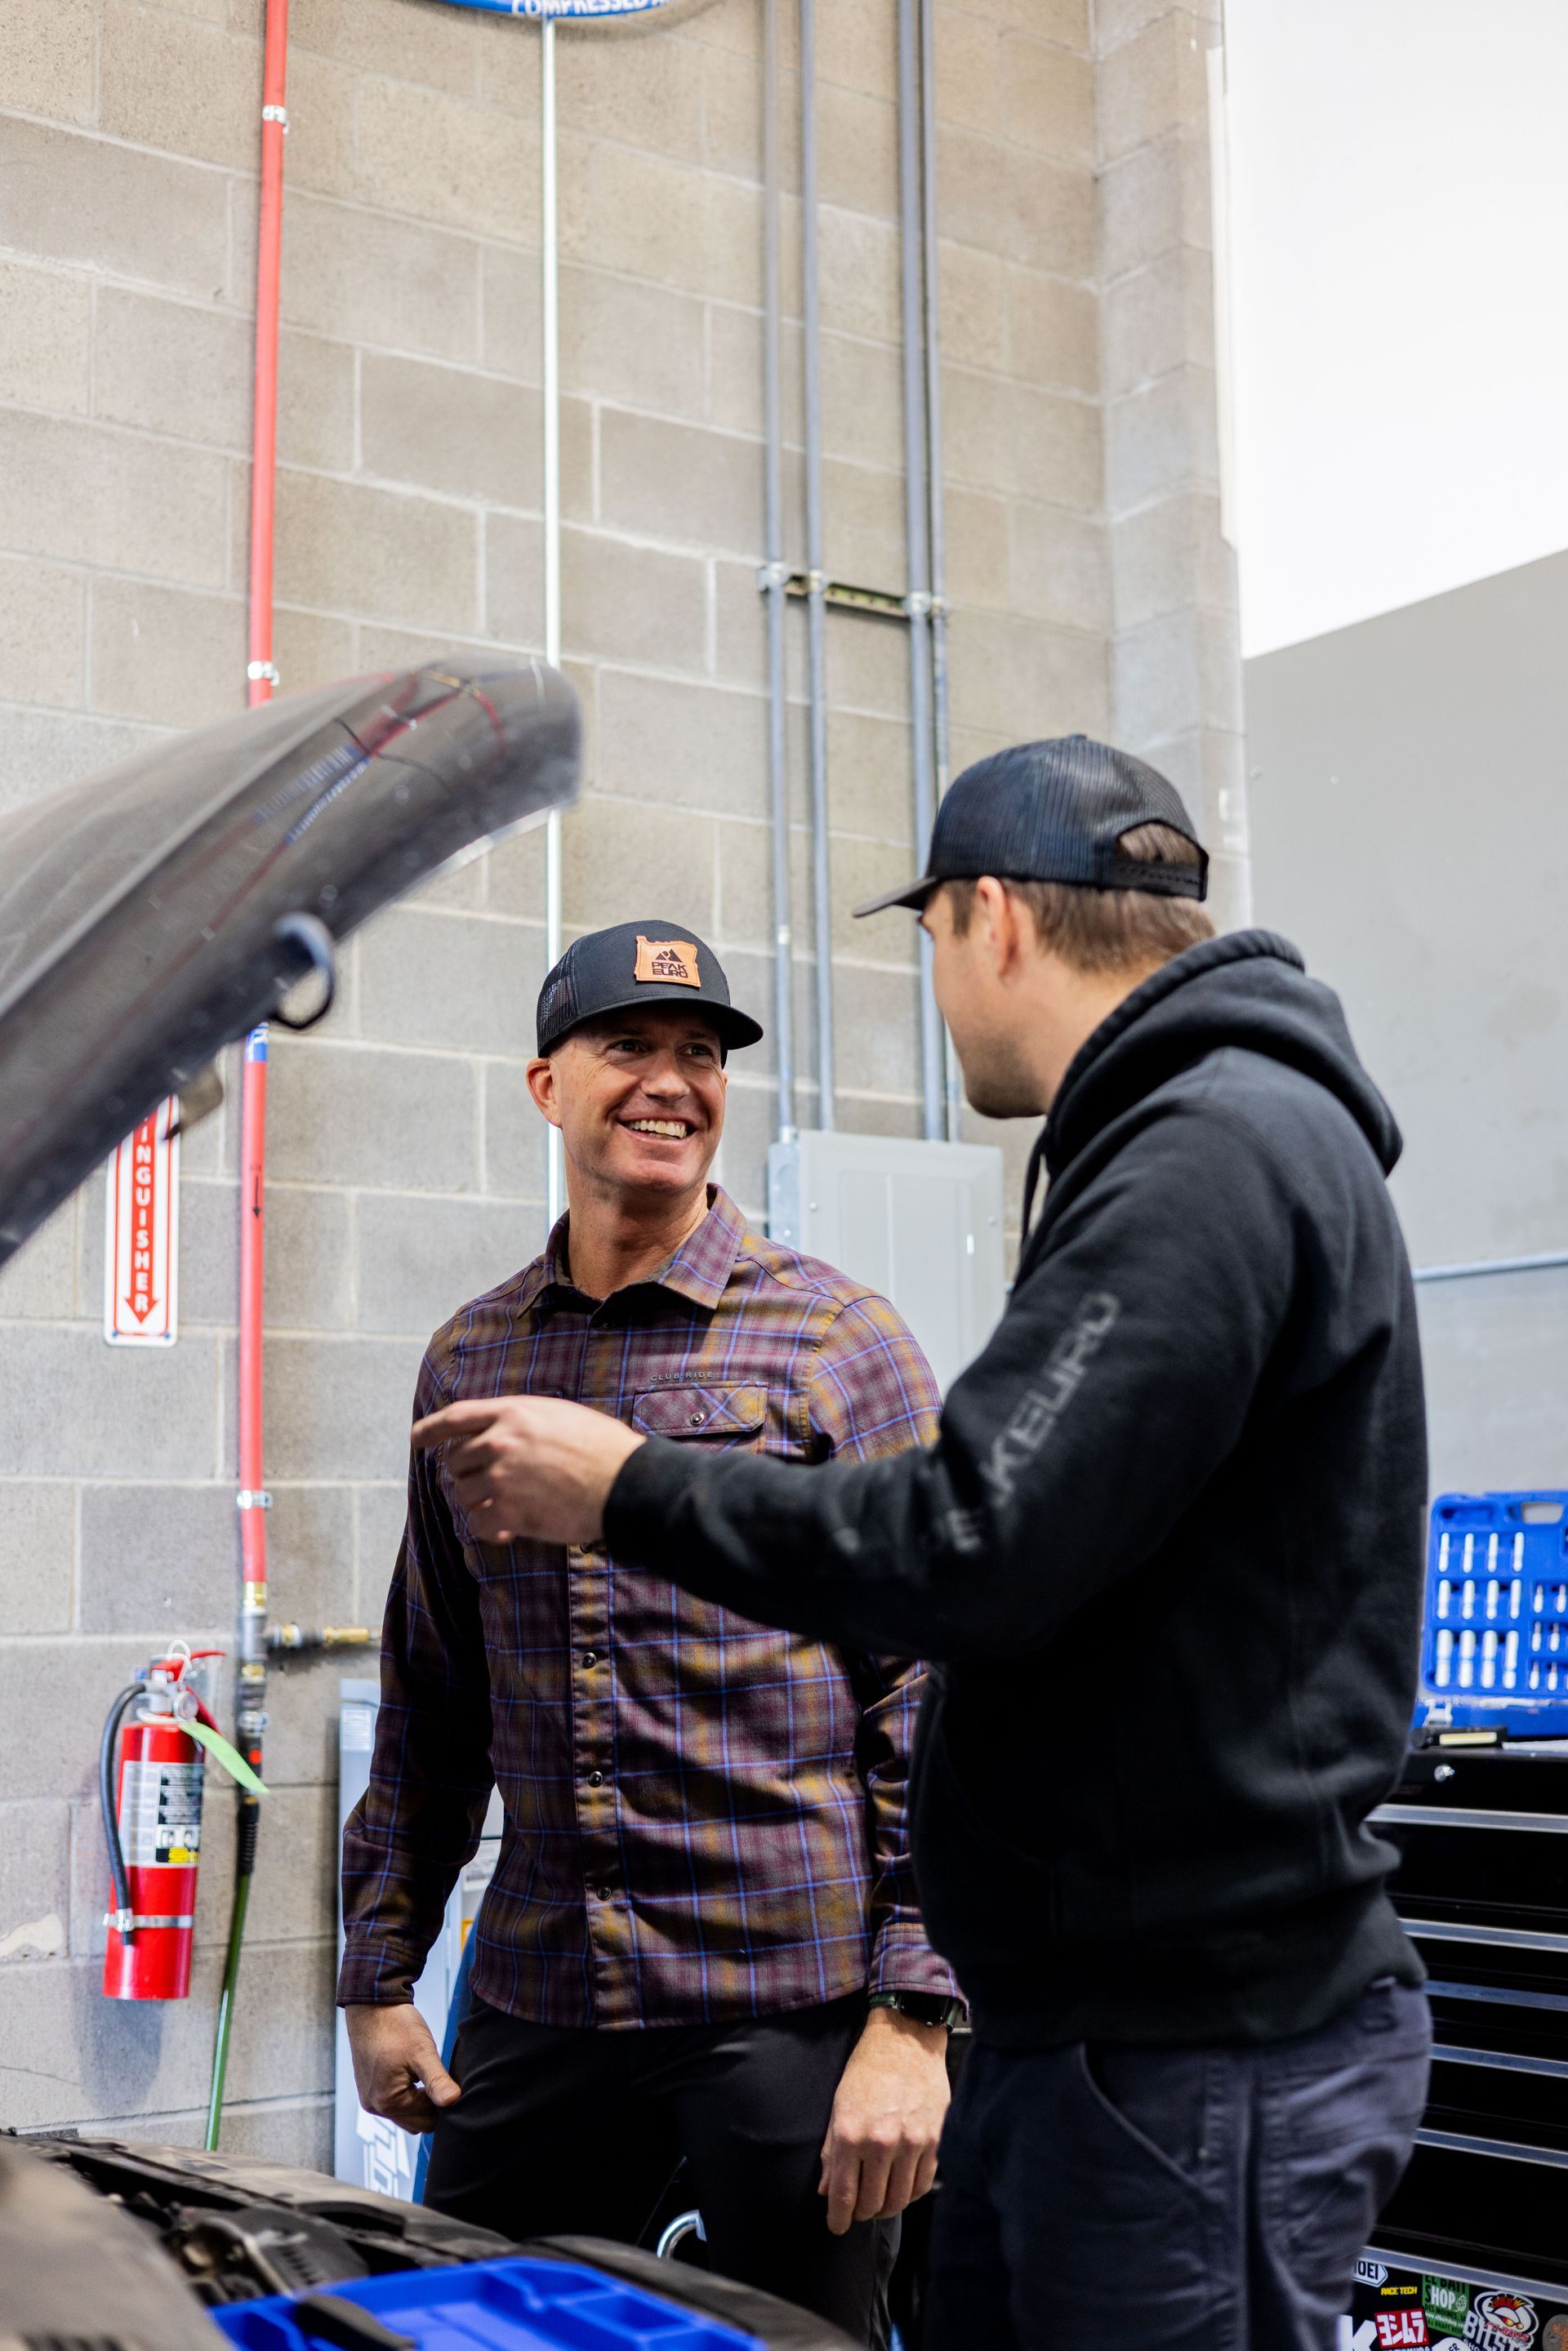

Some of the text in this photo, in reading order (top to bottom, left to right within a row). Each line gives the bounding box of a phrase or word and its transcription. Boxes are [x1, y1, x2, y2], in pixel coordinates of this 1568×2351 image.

[652, 961, 687, 972] PEAK
[653, 968, 688, 978] EURO
[134, 1124, 152, 1313] INGUISHER
[650, 1371, 714, 1382] CLUB RIDE
[1381, 2286, 1418, 2295] RACE TECH
[1425, 2284, 1456, 2310] SHOP
[1425, 2304, 1434, 2313] DES
[1377, 2311, 1424, 2346] ヨシムラ
